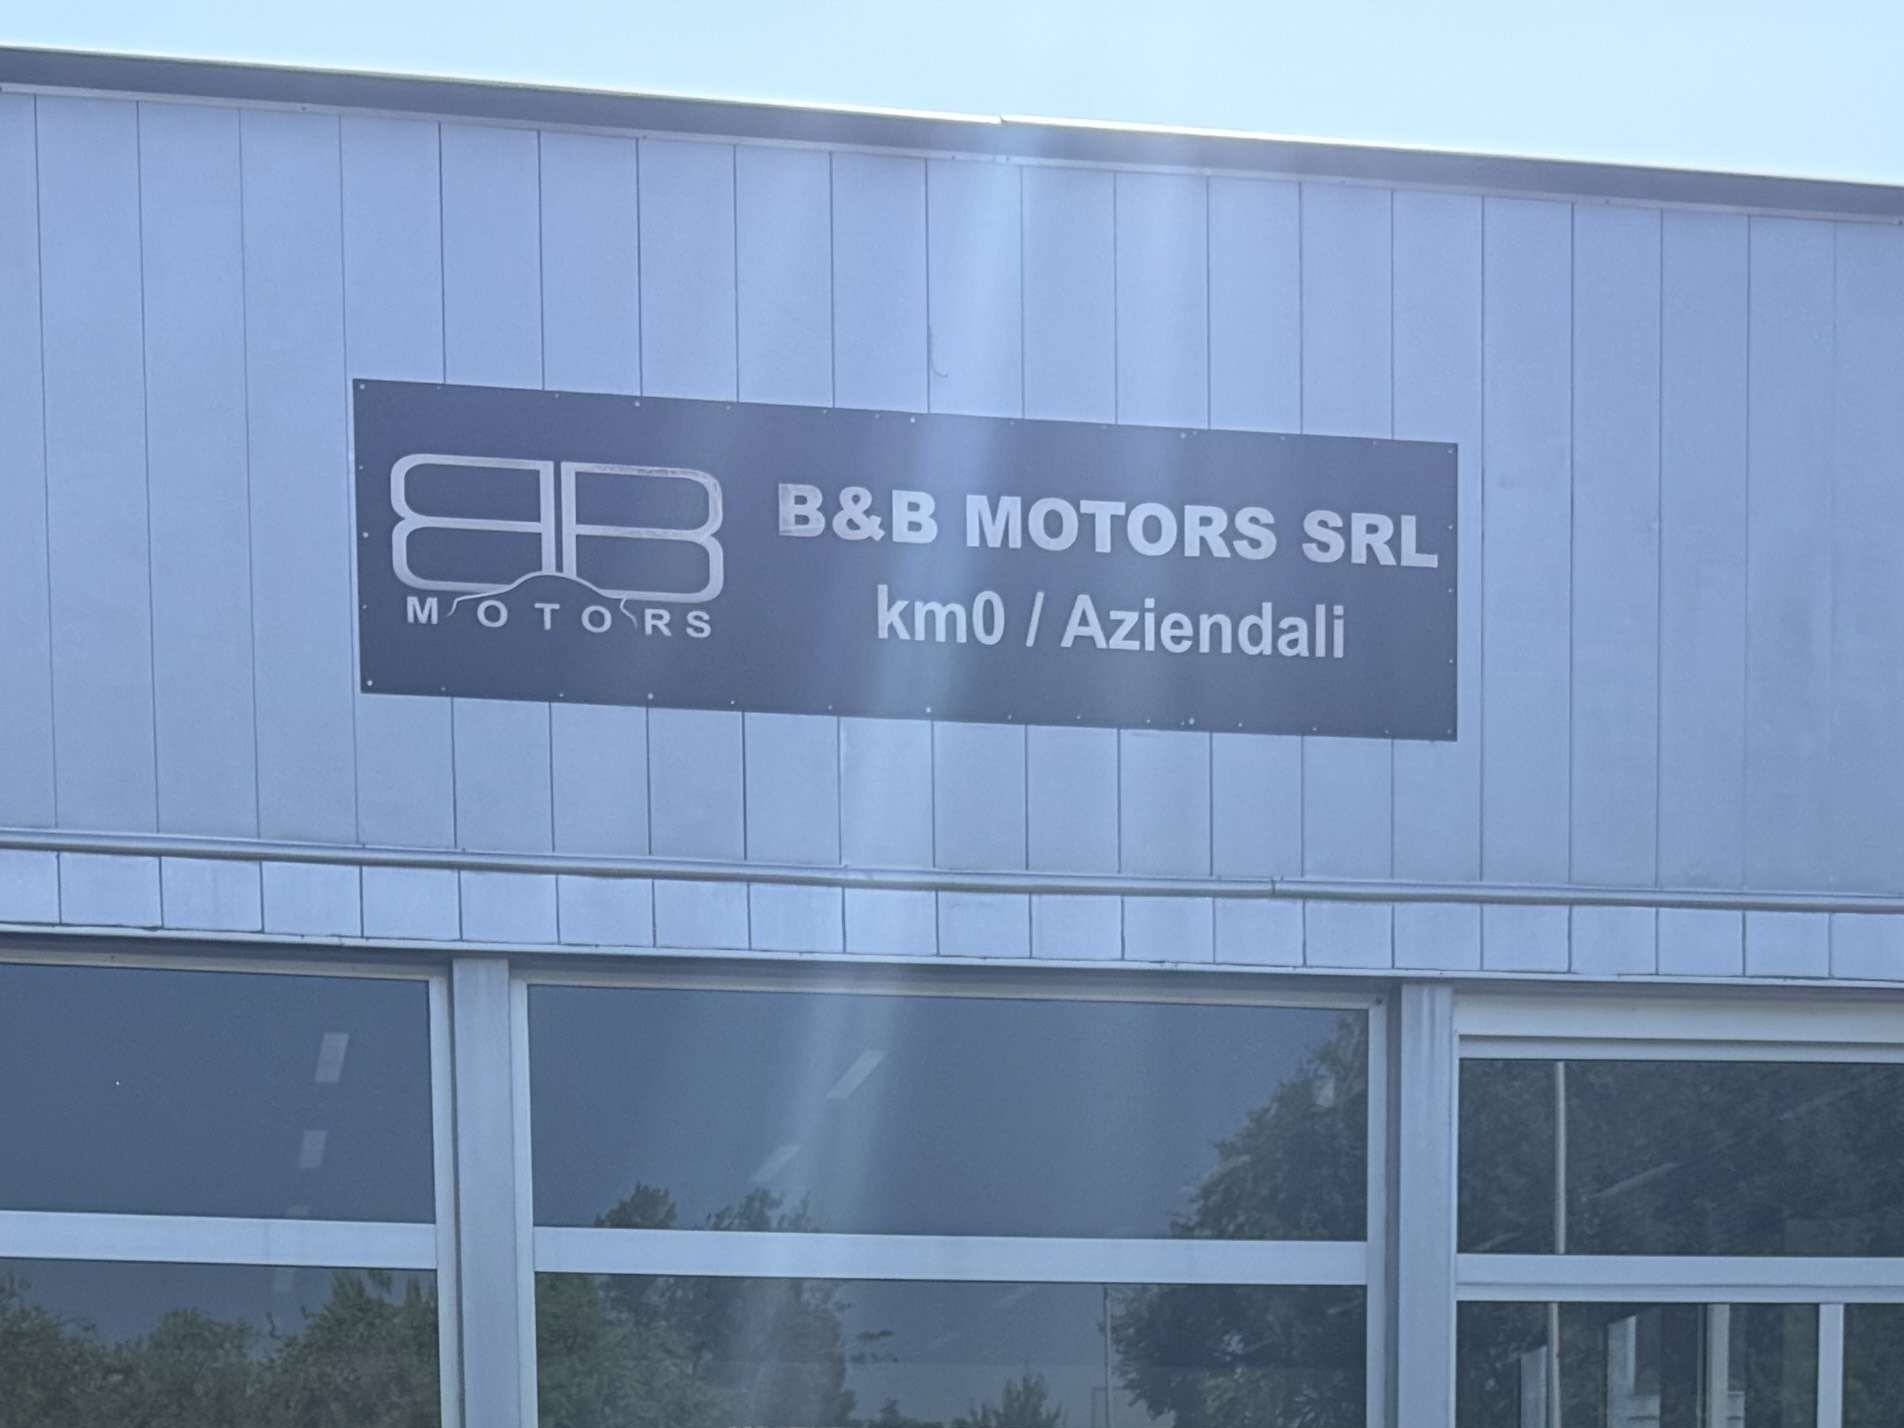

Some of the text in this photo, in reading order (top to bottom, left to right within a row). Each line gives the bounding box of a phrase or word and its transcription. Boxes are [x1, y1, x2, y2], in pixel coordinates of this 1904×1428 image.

[778, 483, 1439, 568] B&B MOTORS SRL
[406, 596, 712, 638] MOTORS
[877, 584, 1006, 645] km0
[1060, 593, 1345, 658] Aziendali
